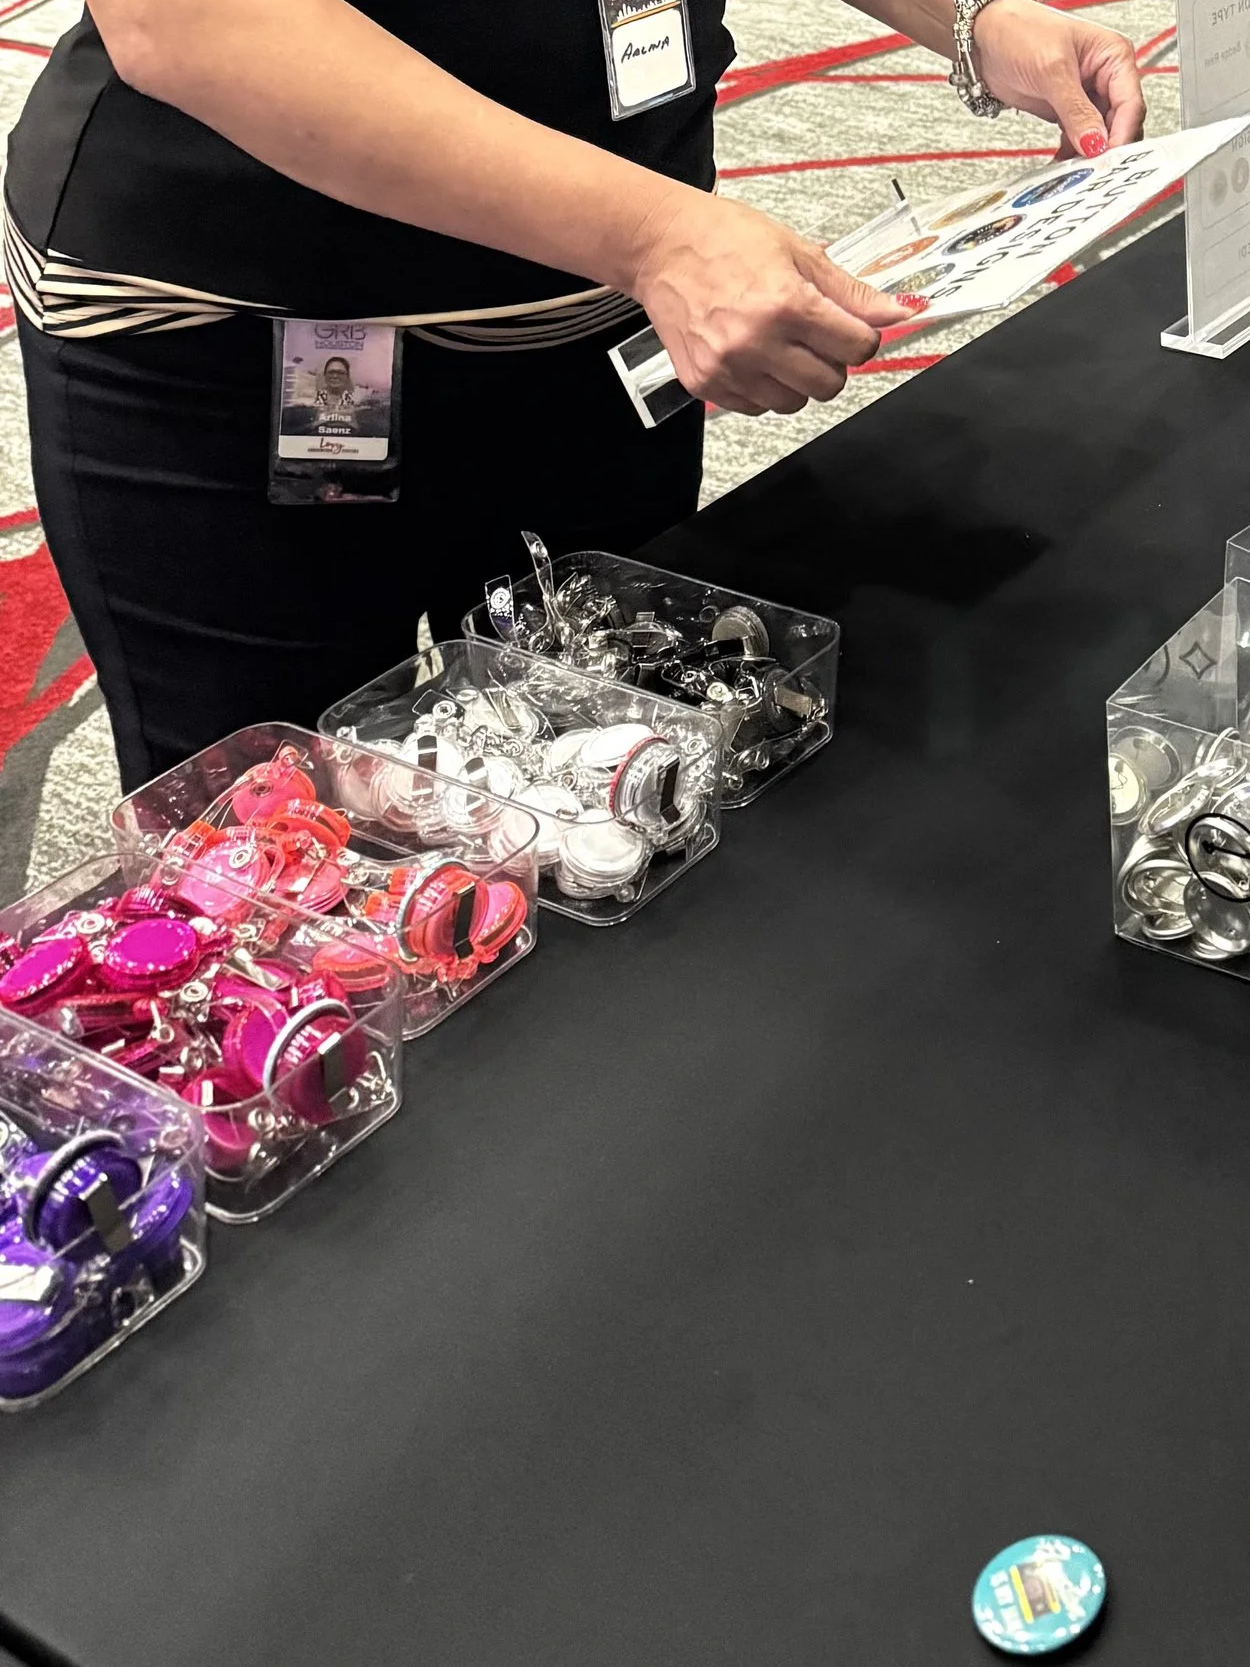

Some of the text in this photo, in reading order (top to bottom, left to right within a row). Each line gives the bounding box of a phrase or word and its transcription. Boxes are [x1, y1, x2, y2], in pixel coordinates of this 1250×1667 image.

[1075, 150, 1155, 195] BAR
[1016, 167, 1159, 260] BUTTON
[929, 198, 1086, 300] DESIGNS
[318, 426, 351, 434] Saenz
